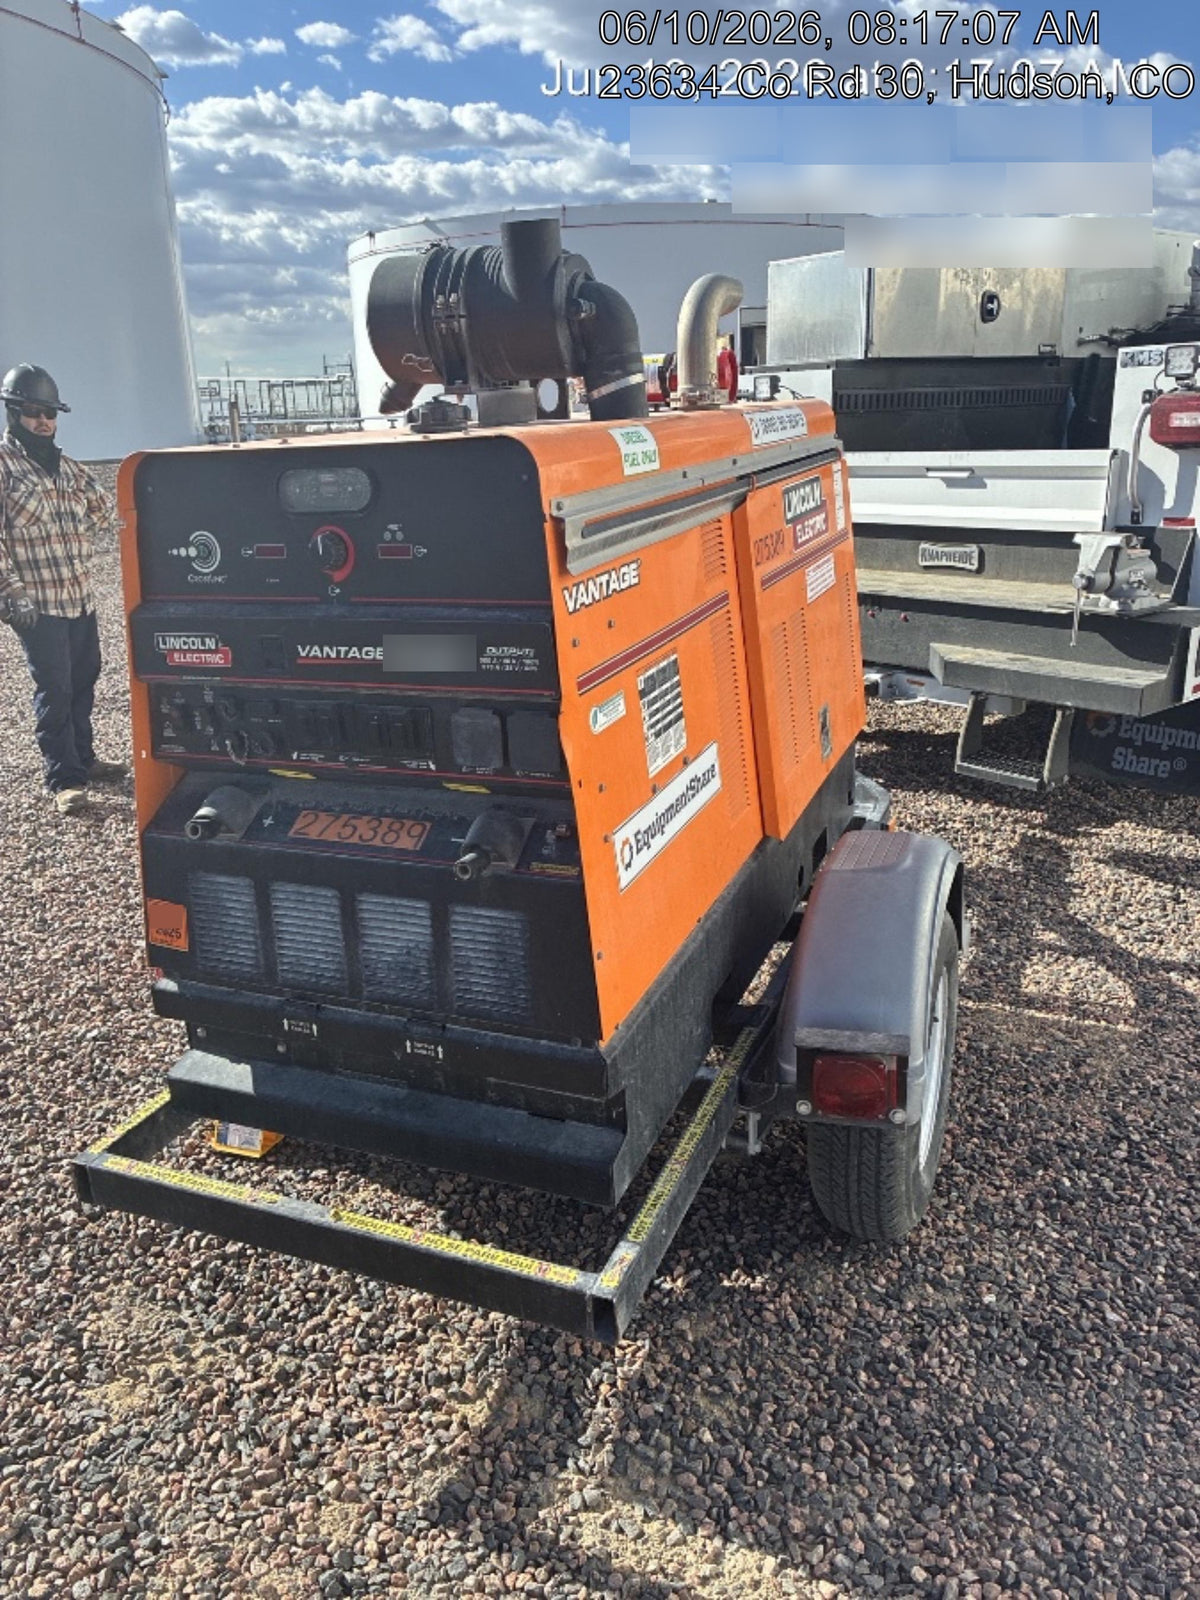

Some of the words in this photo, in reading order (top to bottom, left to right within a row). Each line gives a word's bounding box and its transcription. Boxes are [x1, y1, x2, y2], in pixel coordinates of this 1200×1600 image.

[784, 481, 821, 521] LINCOLN
[795, 511, 826, 544] ELECTRIC
[562, 558, 641, 614] VANTAGE
[157, 636, 217, 651] LINCOLN
[172, 652, 225, 664] ELECTRIC
[297, 644, 384, 660] VANTAGE
[633, 756, 717, 857] EquipmentShare
[293, 811, 430, 849] 275389
